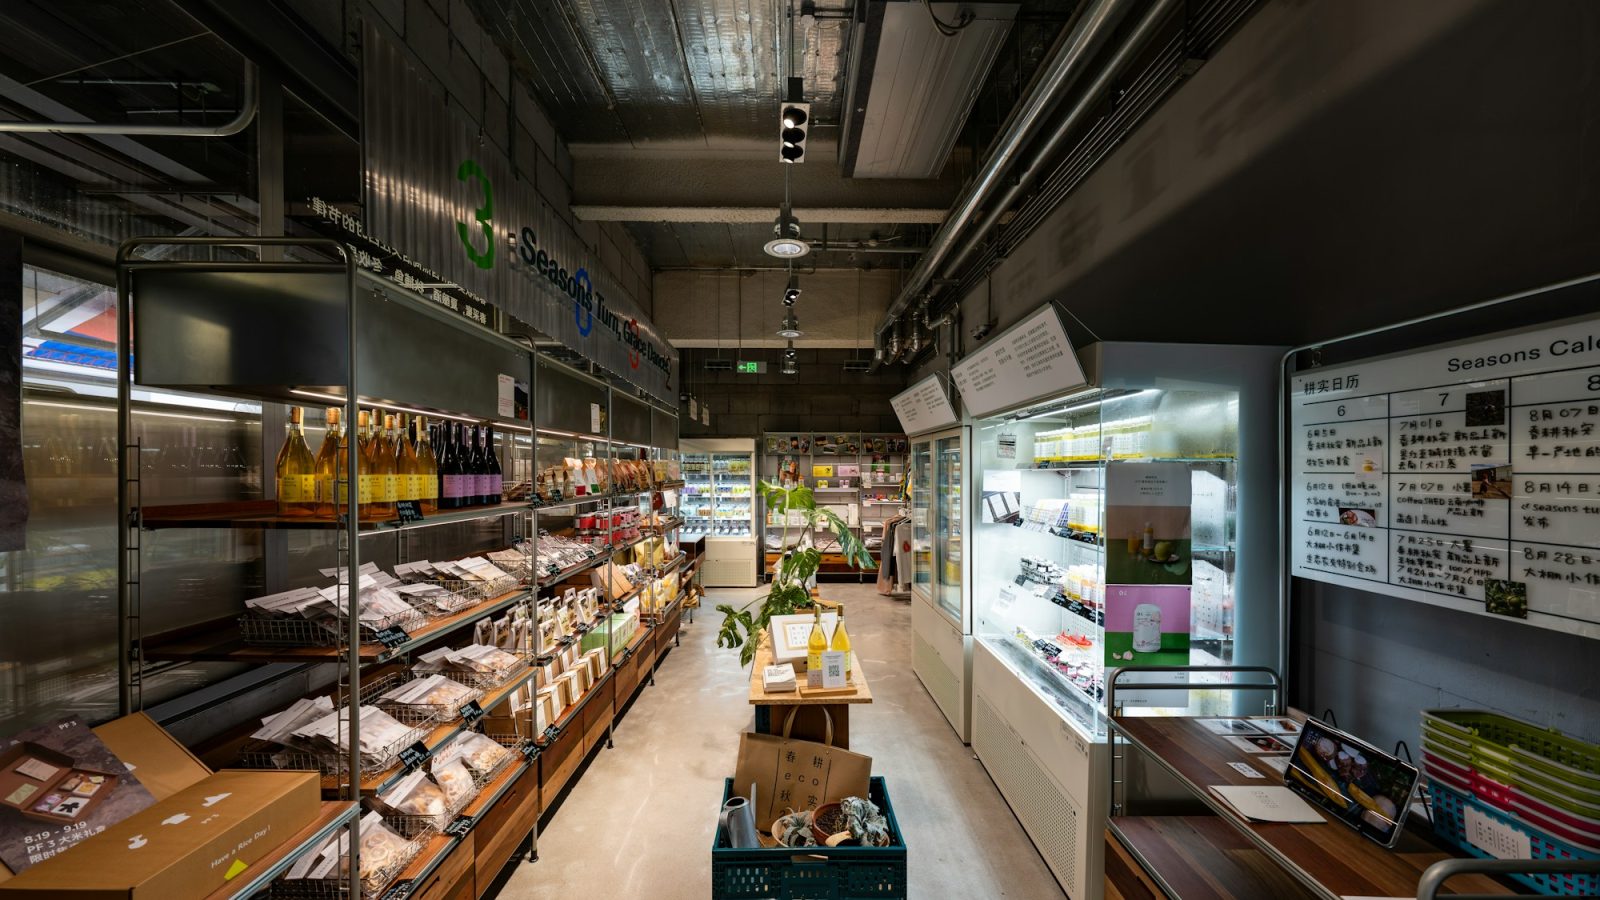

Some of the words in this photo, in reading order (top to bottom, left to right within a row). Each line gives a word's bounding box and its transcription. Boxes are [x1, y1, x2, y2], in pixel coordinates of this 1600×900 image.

[457, 159, 494, 270] 3
[521, 227, 592, 312] Seasons
[596, 291, 621, 341] Turn,
[1447, 348, 1541, 372] Seasons
[1304, 374, 1359, 396] 耕实日历
[1337, 405, 1346, 417] 6
[1438, 393, 1449, 406] 7
[1587, 374, 1600, 391] 8
[1454, 428, 1507, 442] 新品上新
[1528, 422, 1594, 440] 春耕秋实
[1306, 482, 1334, 491] 6月12日
[1523, 515, 1550, 529] 发布
[1446, 551, 1500, 567] 新品上新
[58, 722, 69, 731] PF
[784, 772, 819, 786] eco
[24, 831, 50, 844] 8.19
[63, 821, 87, 836] 9.19
[26, 843, 45, 856] PF
[47, 840, 55, 849] 3
[211, 853, 229, 869] Have
[238, 838, 253, 851] Rice
